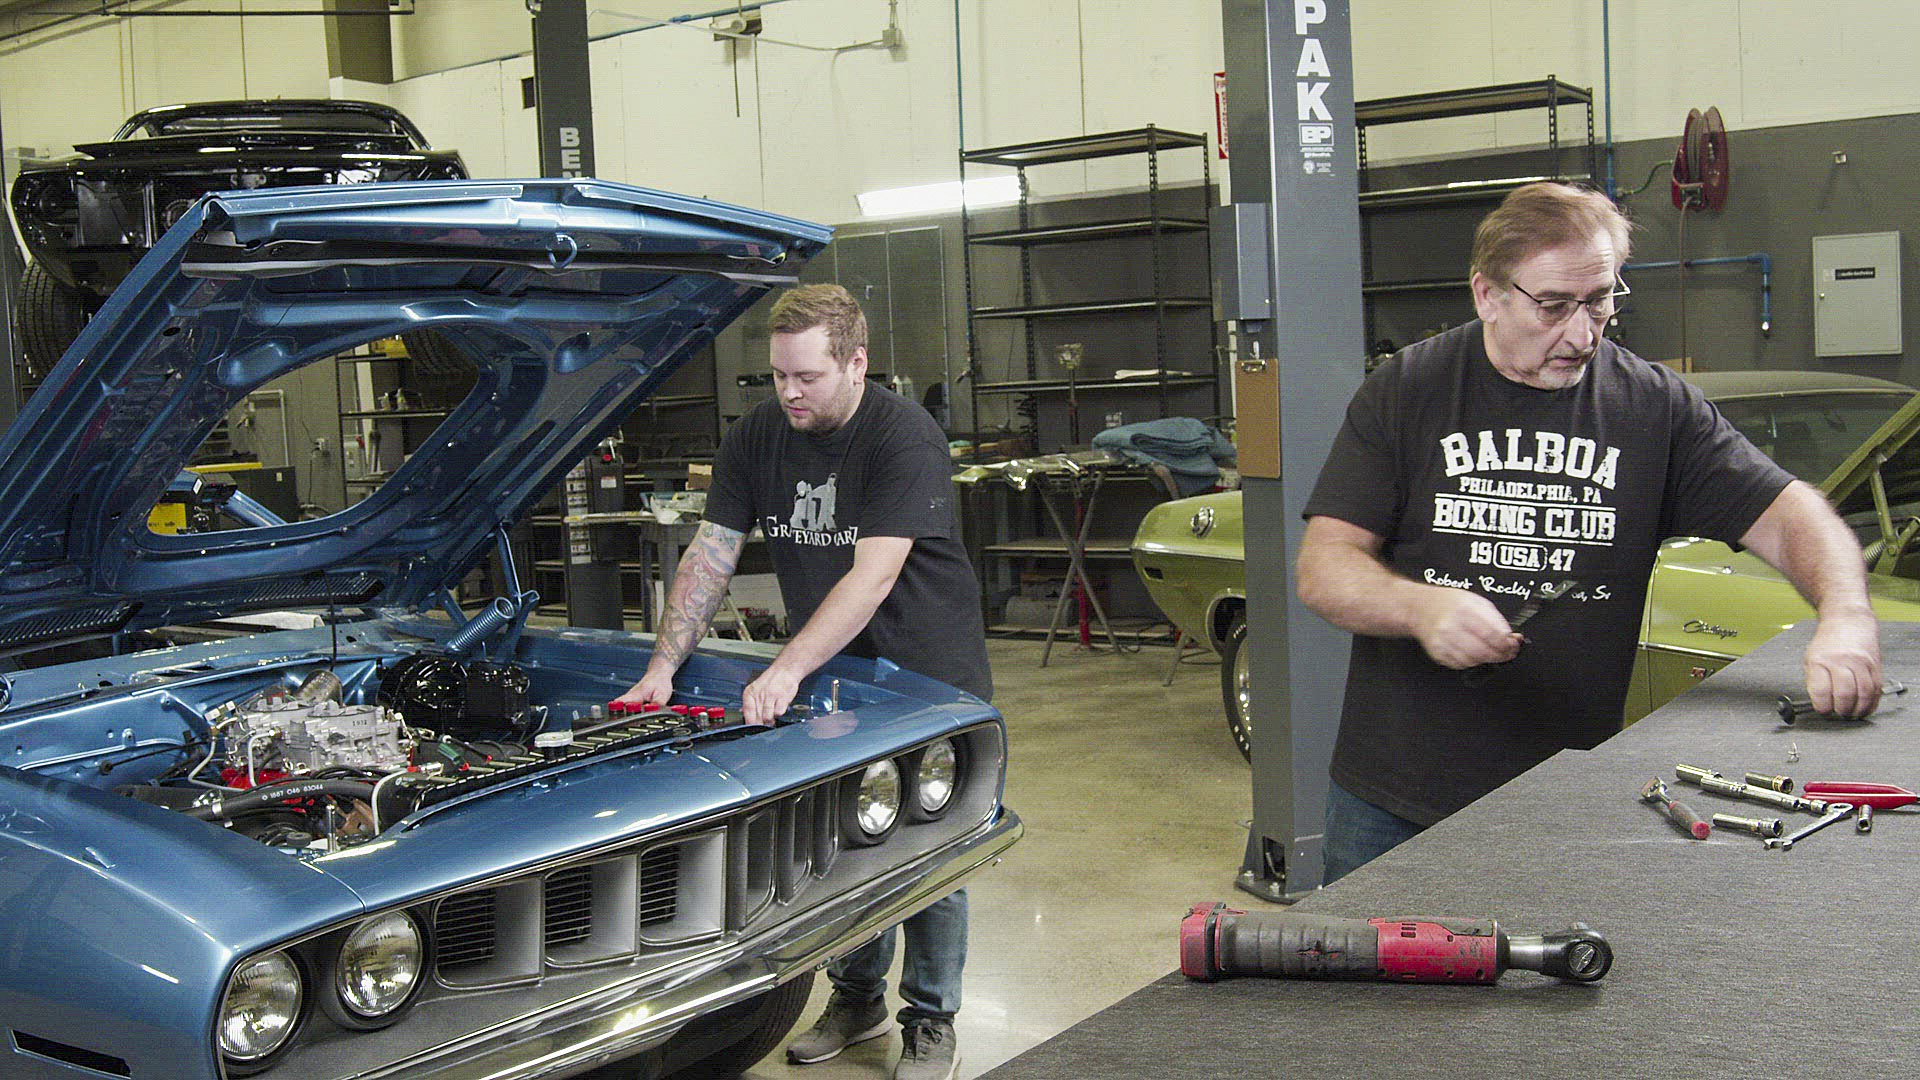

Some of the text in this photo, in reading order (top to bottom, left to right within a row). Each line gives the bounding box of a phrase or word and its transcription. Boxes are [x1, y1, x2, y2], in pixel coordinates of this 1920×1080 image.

[1294, 0, 1333, 120] PAK
[1301, 126, 1331, 143] BP
[1439, 428, 1620, 490] BALBOA
[1459, 476, 1602, 504] PHILADELPHIA, PA
[766, 515, 832, 546] GREYARD
[1433, 497, 1616, 541] BOXING CLUB
[1469, 541, 1576, 571] 19 USA 47
[1424, 568, 1473, 589] Robert
